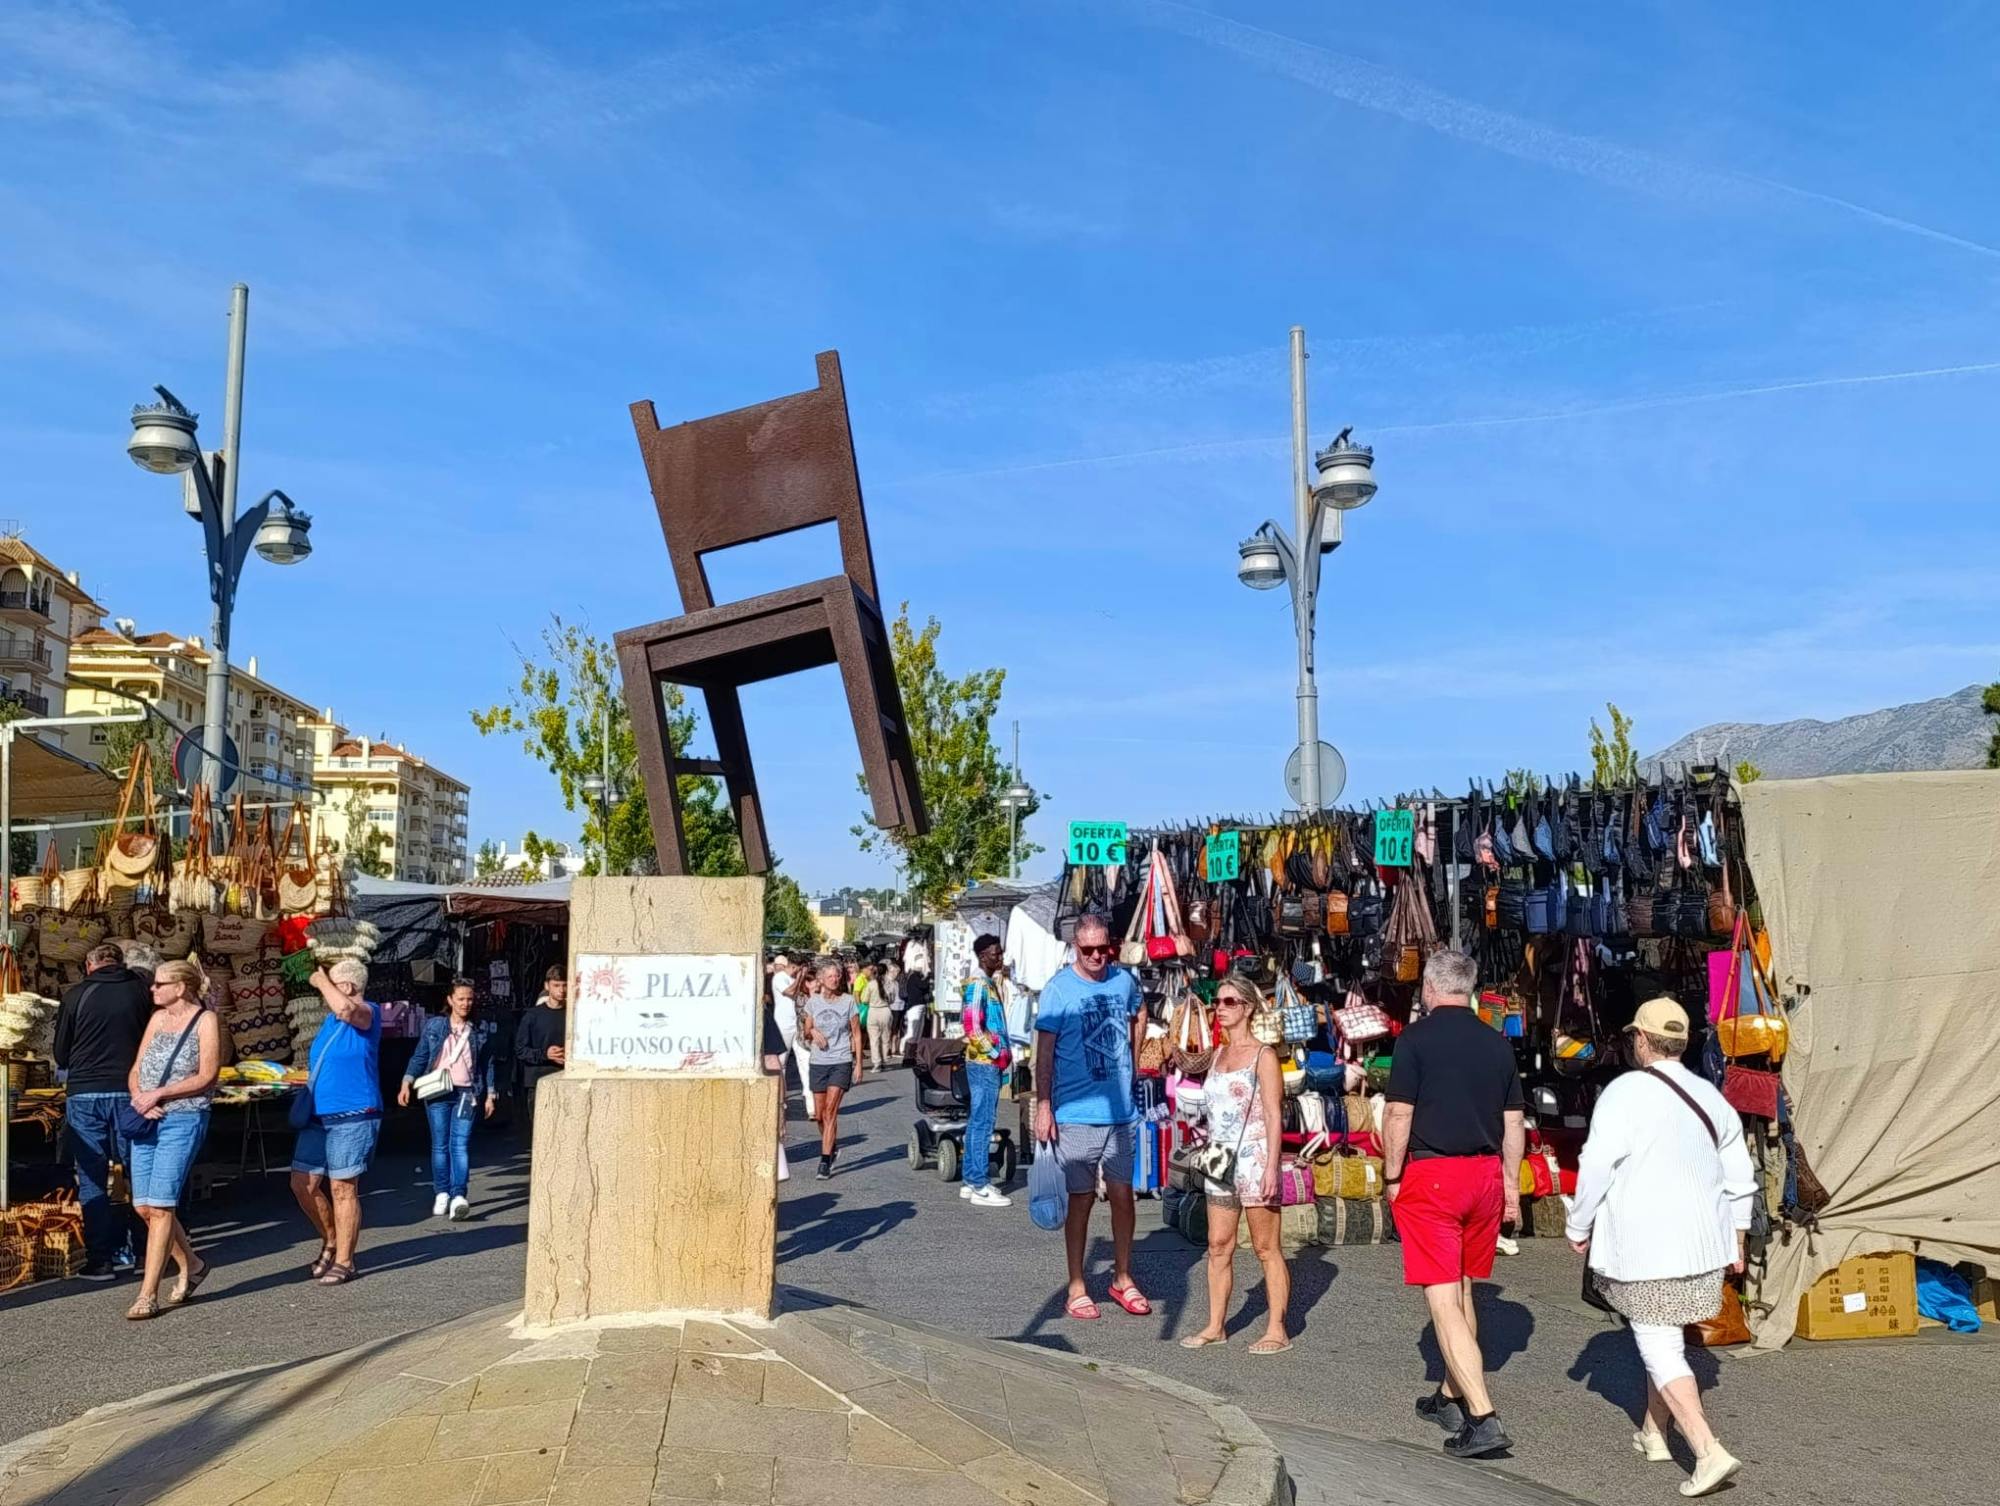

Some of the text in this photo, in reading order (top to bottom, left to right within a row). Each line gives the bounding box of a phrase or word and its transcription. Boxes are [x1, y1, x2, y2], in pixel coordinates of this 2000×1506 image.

[1073, 827, 1122, 839] OFERTA
[1380, 817, 1411, 832] OFERTA
[1074, 842, 1120, 862] 10 €
[1380, 837, 1409, 862] 10 €
[1210, 854, 1234, 878] 10 €
[646, 973, 732, 998] PLAZA
[584, 1030, 744, 1055] ALFONSO GALÁN
